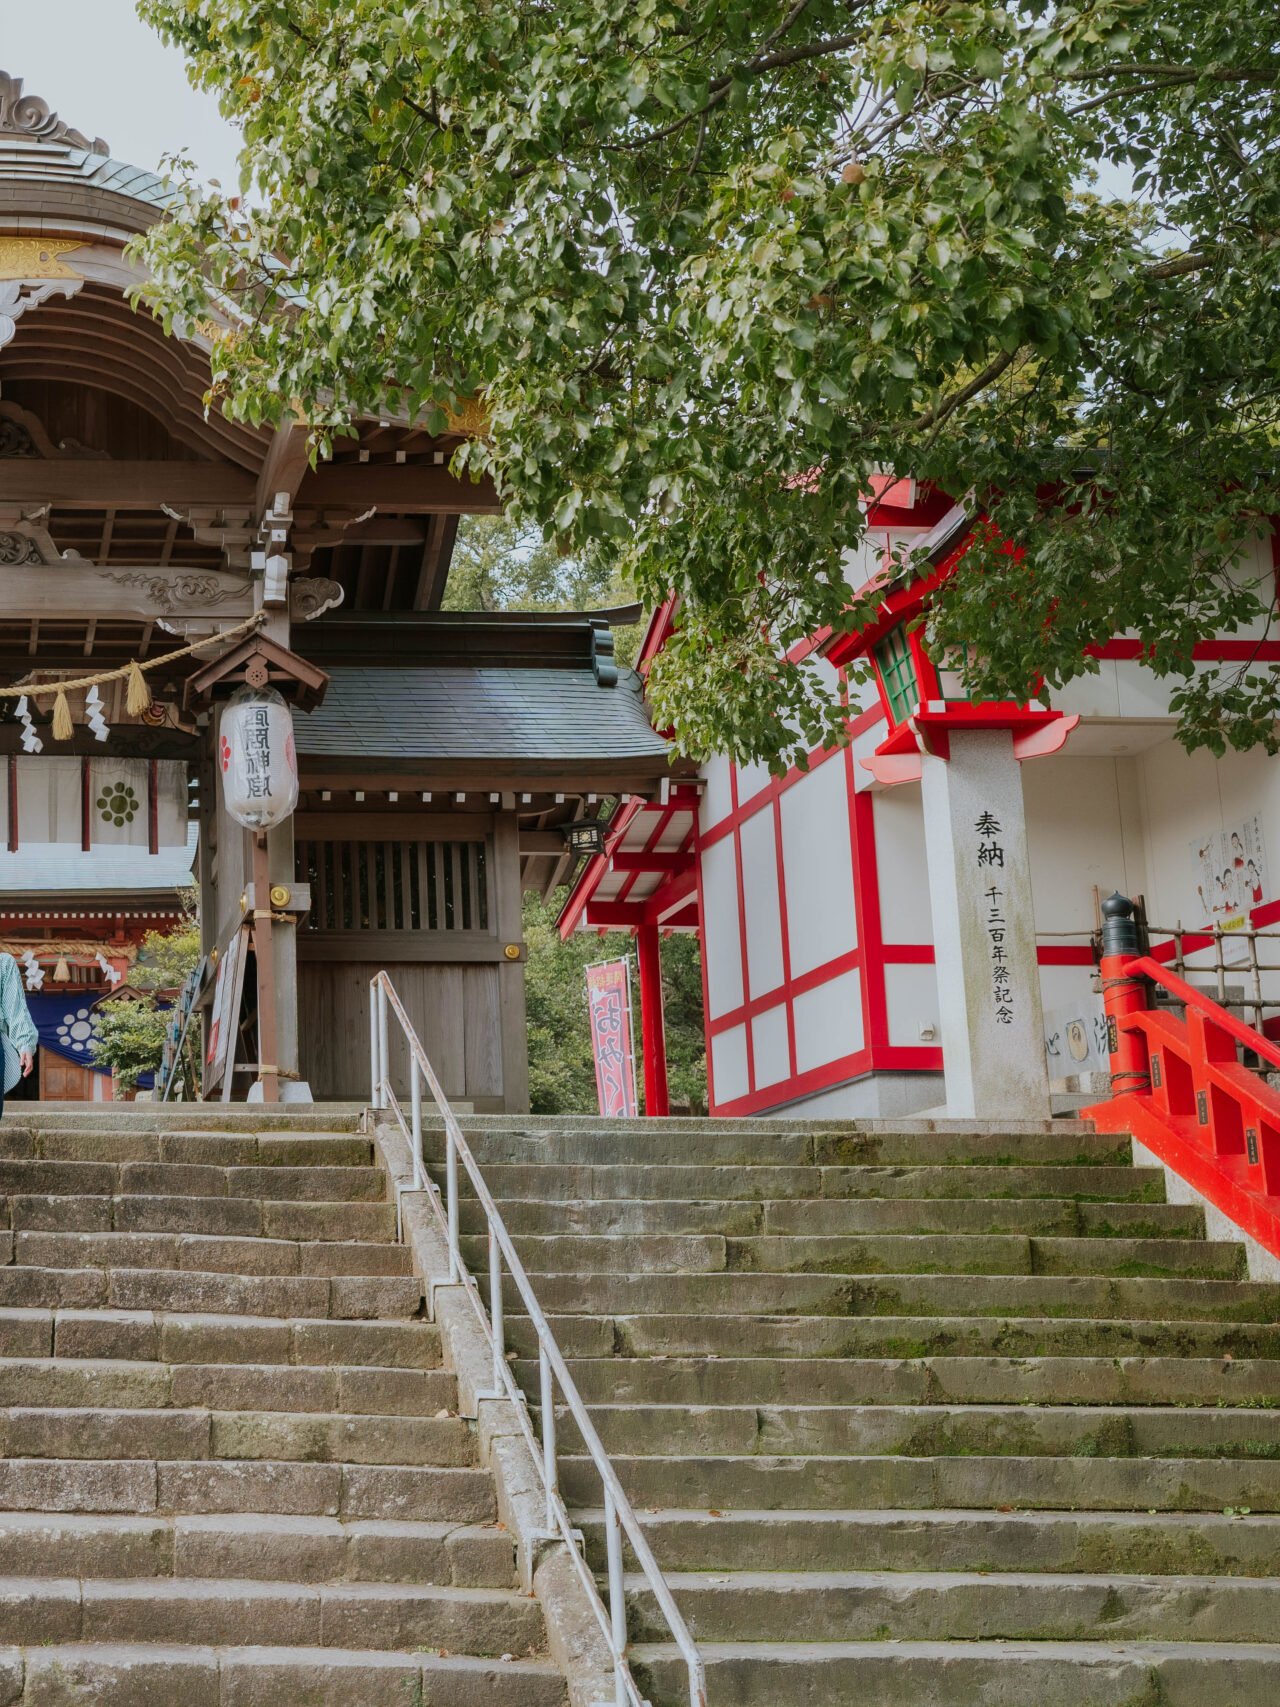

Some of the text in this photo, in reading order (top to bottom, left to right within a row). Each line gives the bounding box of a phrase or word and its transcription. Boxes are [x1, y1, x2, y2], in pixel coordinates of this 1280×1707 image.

[974, 811, 1014, 1024] 奉納 千三百年祭記念
